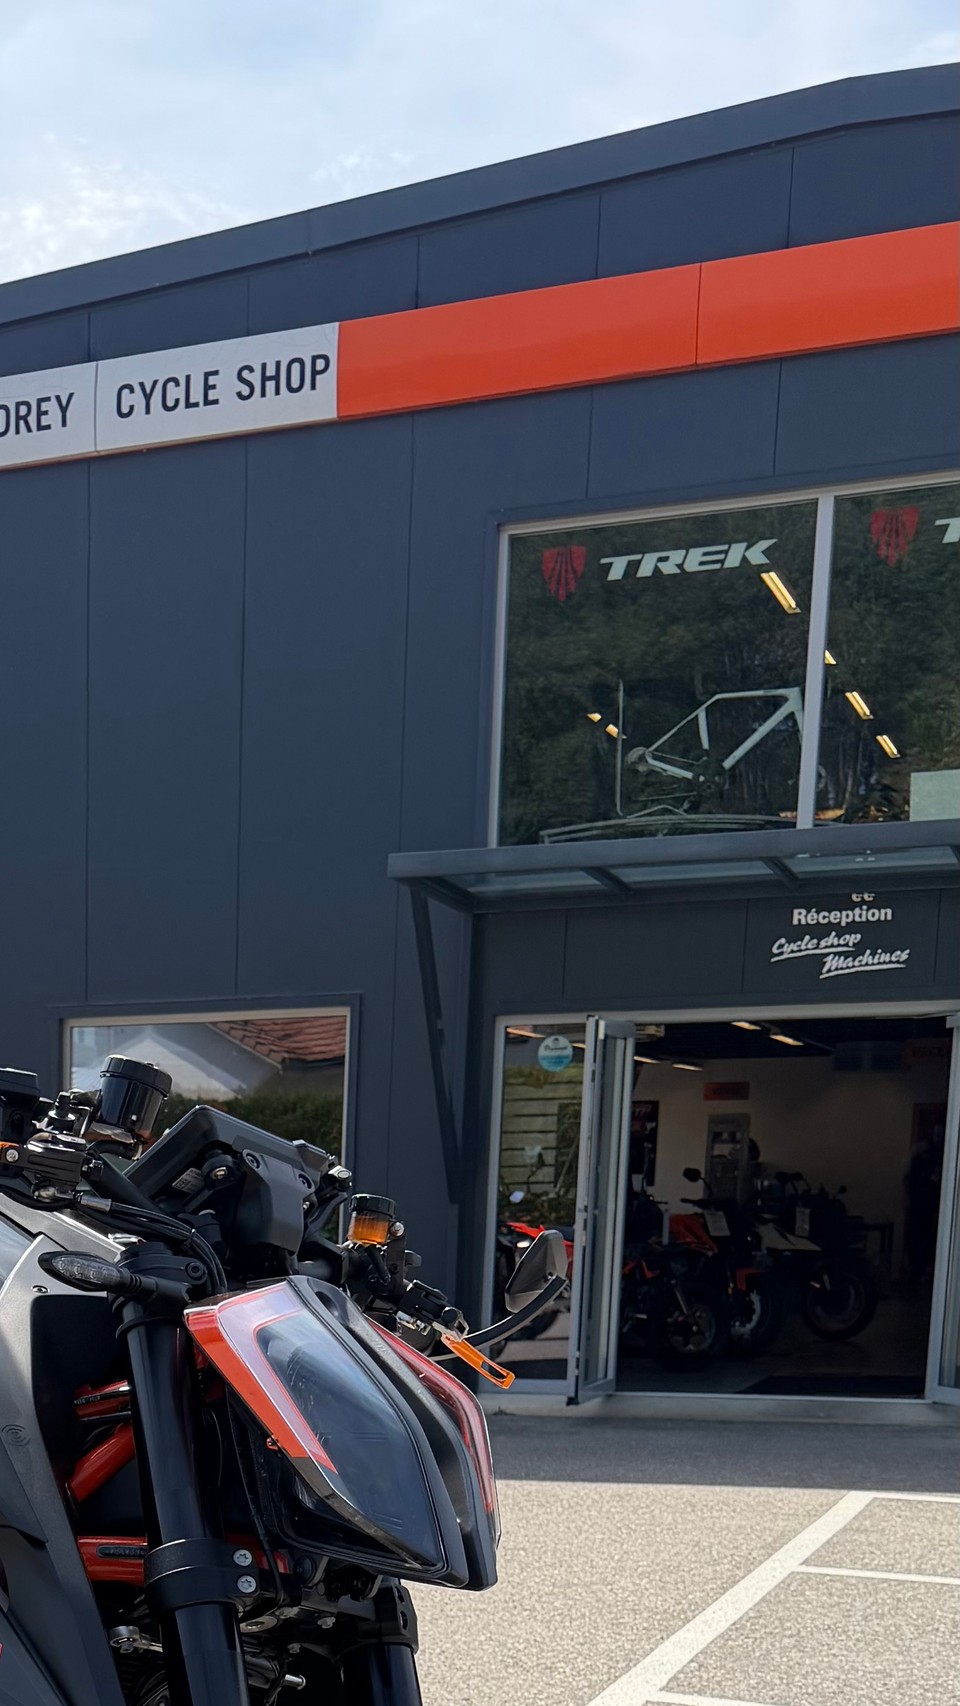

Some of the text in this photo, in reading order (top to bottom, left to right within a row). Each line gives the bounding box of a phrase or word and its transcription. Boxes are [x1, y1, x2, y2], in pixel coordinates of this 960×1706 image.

[115, 369, 220, 420] CYCLE
[234, 353, 331, 401] SHOP
[600, 538, 779, 581] TREK
[792, 905, 892, 926] Réception
[821, 949, 910, 974] Machines
